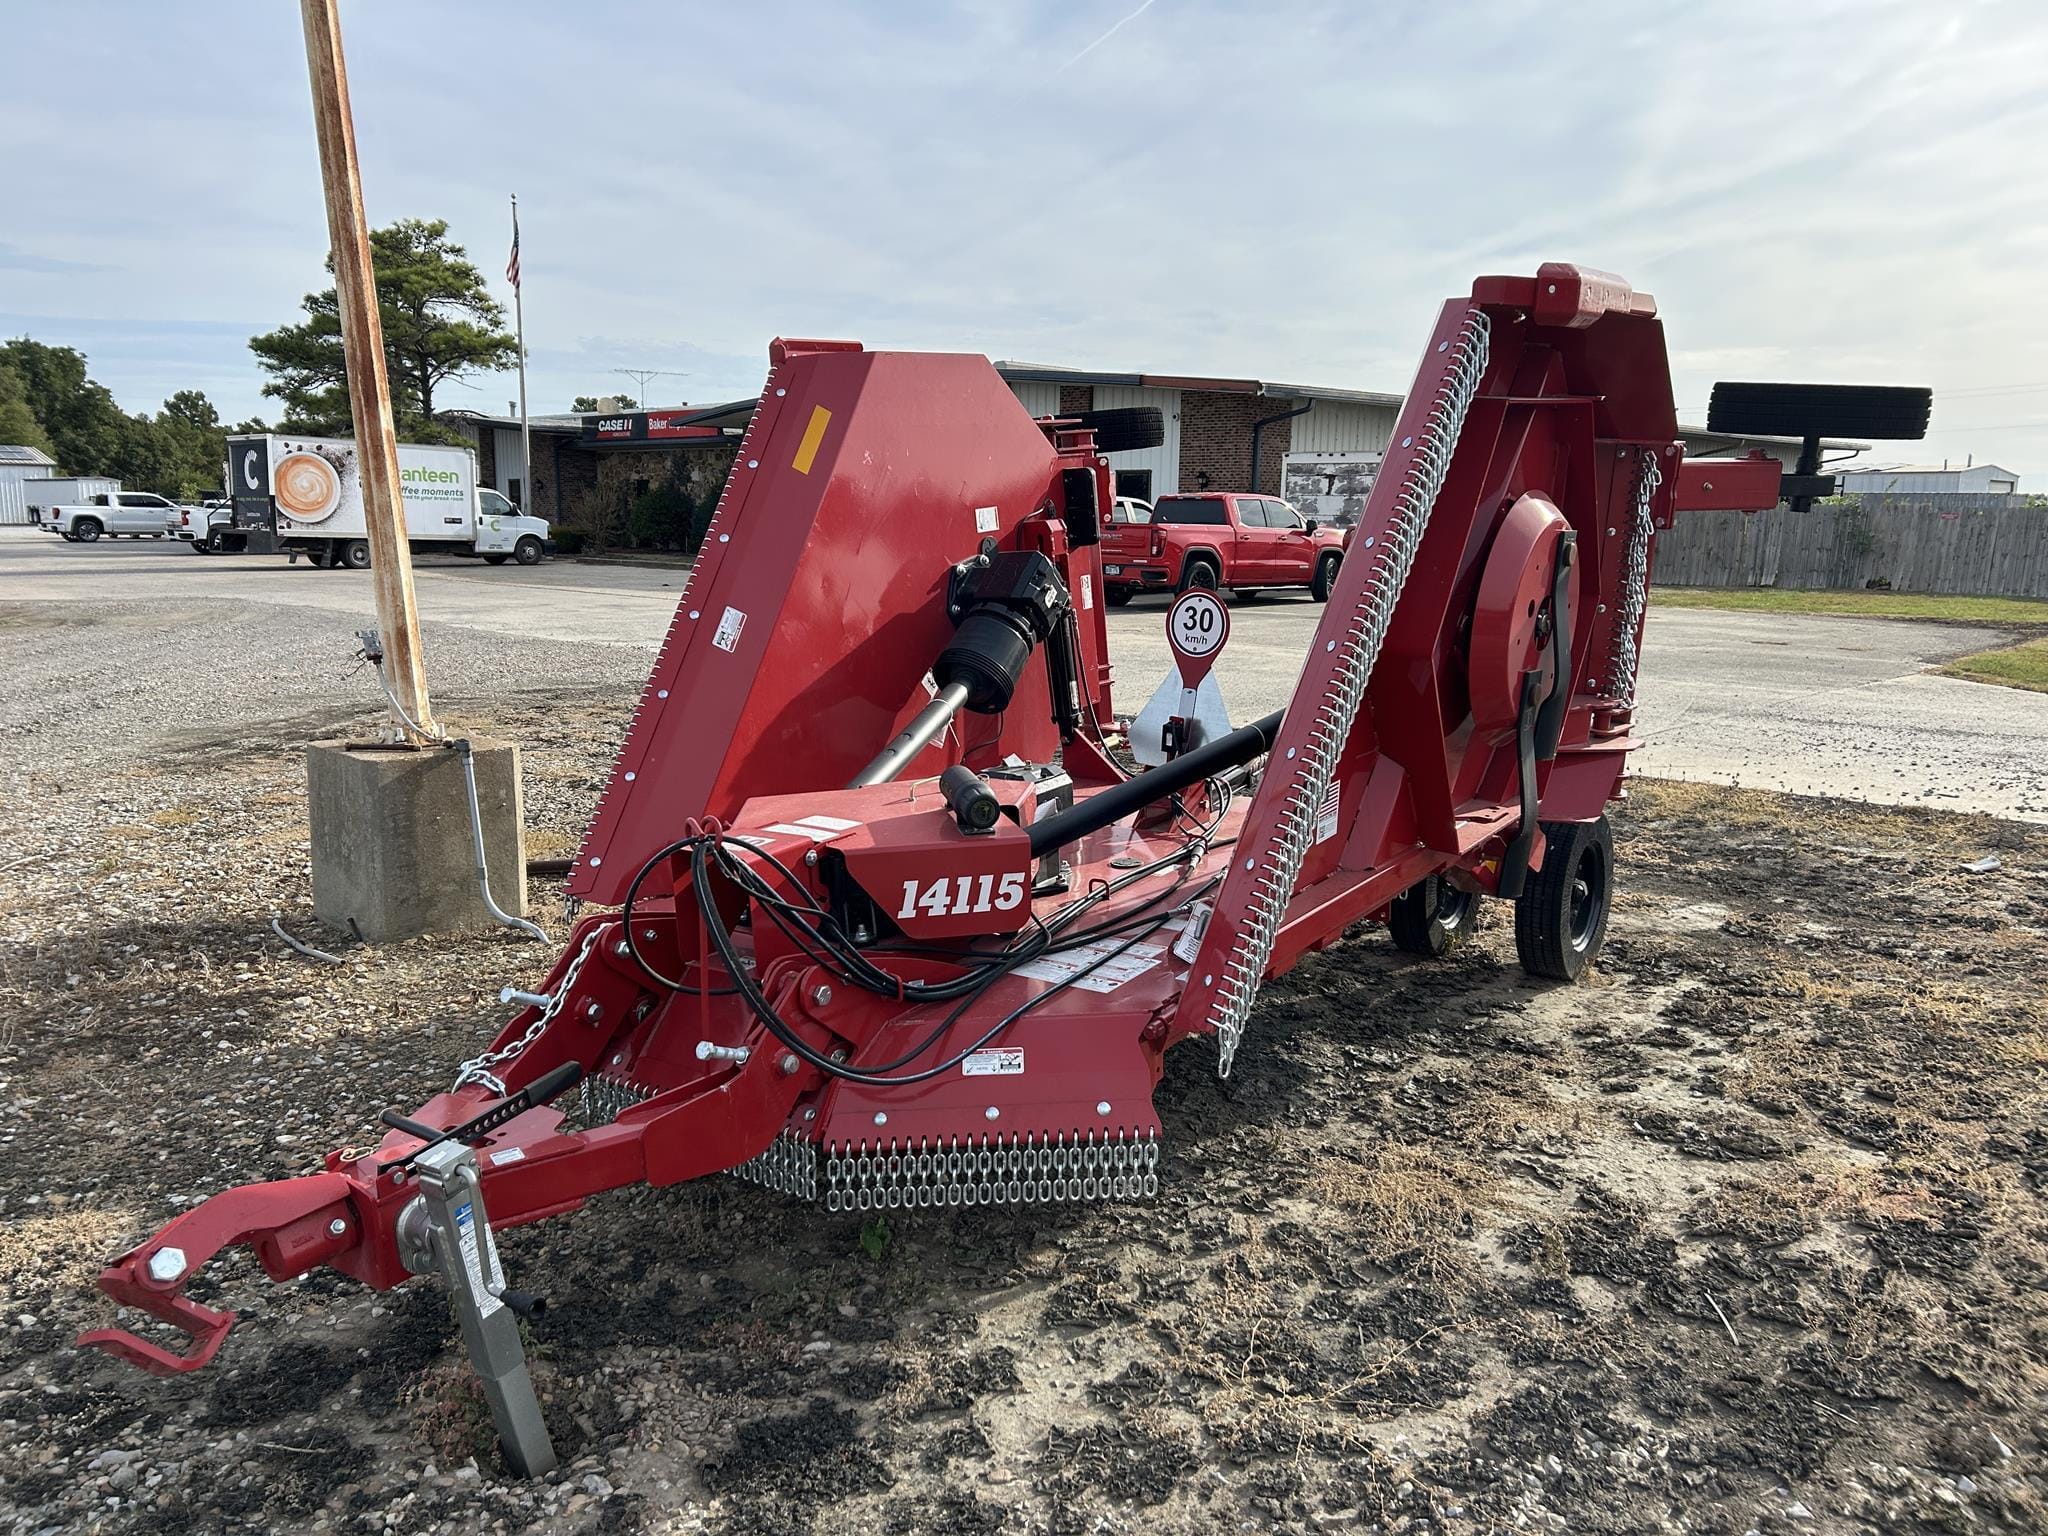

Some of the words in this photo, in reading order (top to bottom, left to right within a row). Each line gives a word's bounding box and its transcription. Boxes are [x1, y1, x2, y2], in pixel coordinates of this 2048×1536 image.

[598, 420, 624, 432] CASE
[648, 418, 668, 430] Baker
[402, 466, 459, 484] anteen
[401, 486, 420, 494] ffee
[422, 488, 464, 496] moments
[1183, 605, 1214, 633] 30
[1185, 633, 1208, 646] km/h
[897, 872, 1026, 919] 14115
